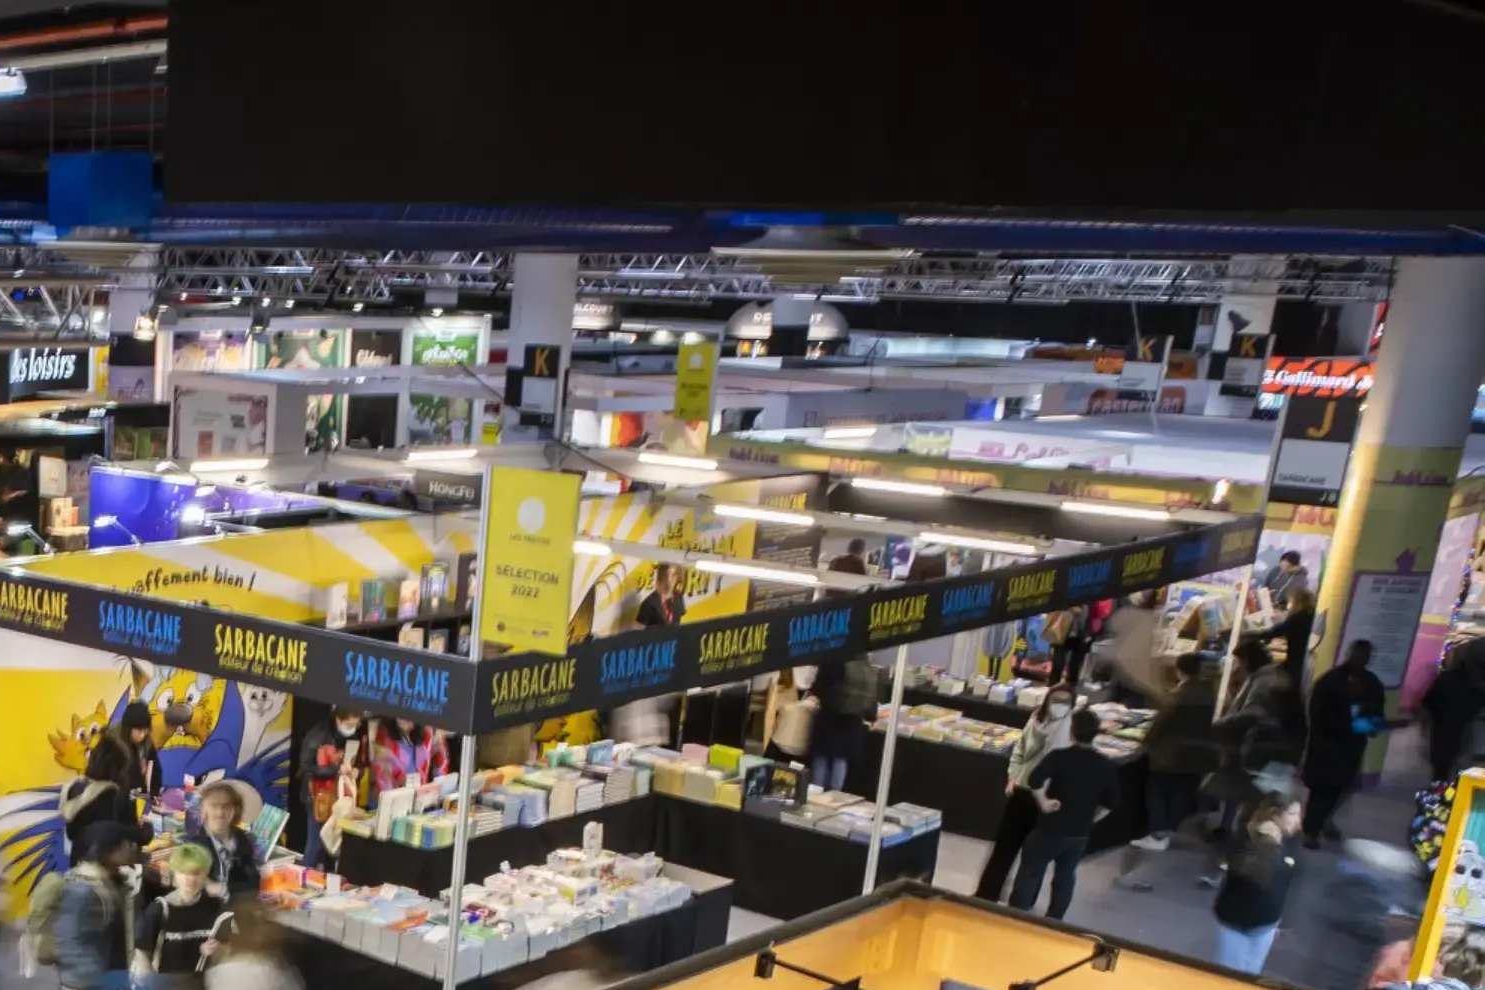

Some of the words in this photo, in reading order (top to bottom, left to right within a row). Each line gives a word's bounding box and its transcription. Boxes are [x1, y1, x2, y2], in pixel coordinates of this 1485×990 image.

[28, 347, 76, 381] loisirs
[535, 348, 551, 376] K
[1275, 369, 1356, 391] Gallimard
[1307, 400, 1337, 438] J
[429, 481, 475, 500] HONGFEI
[214, 565, 244, 589] bien
[511, 583, 540, 599] 2022
[99, 599, 182, 644] SARBACANE
[788, 606, 853, 646] SARBACANE
[869, 593, 929, 629] SARBACANE
[215, 623, 309, 674] SARBACANE
[600, 639, 679, 685] SARBACANE
[699, 622, 770, 664] SARBACANE
[346, 651, 451, 704] SARBACANE
[491, 658, 577, 706] SARBACANE
